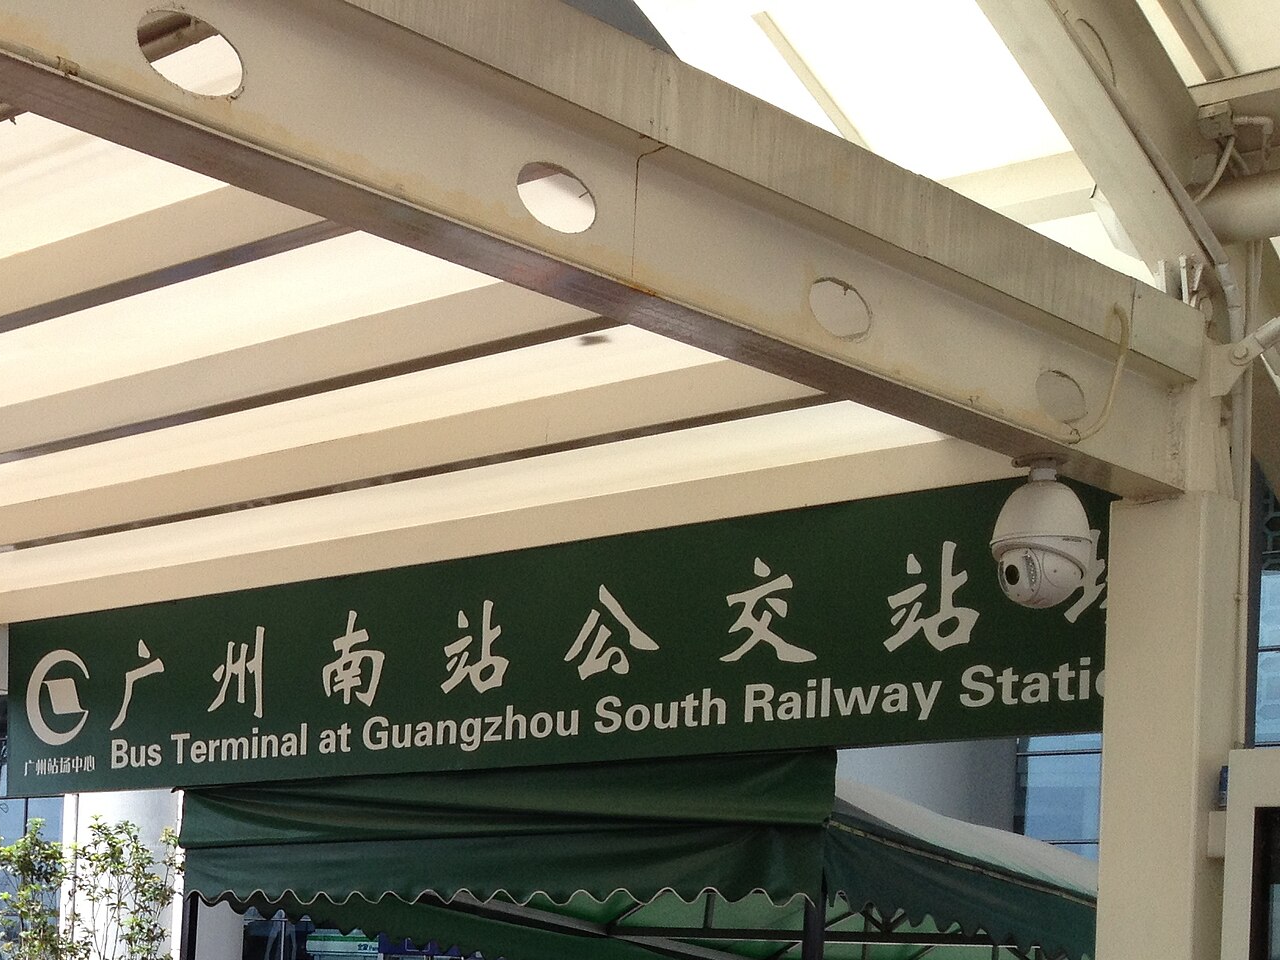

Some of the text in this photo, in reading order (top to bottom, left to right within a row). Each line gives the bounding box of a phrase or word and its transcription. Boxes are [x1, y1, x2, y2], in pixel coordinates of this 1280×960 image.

[109, 529, 1107, 731] 广州南站公交站
[24, 754, 96, 776] 广州站场中心
[111, 738, 162, 770] Bus
[171, 722, 308, 764] Terminal
[319, 723, 351, 754] at
[362, 704, 580, 751] Guangzhou
[594, 687, 727, 734] South
[744, 676, 943, 723] Railway
